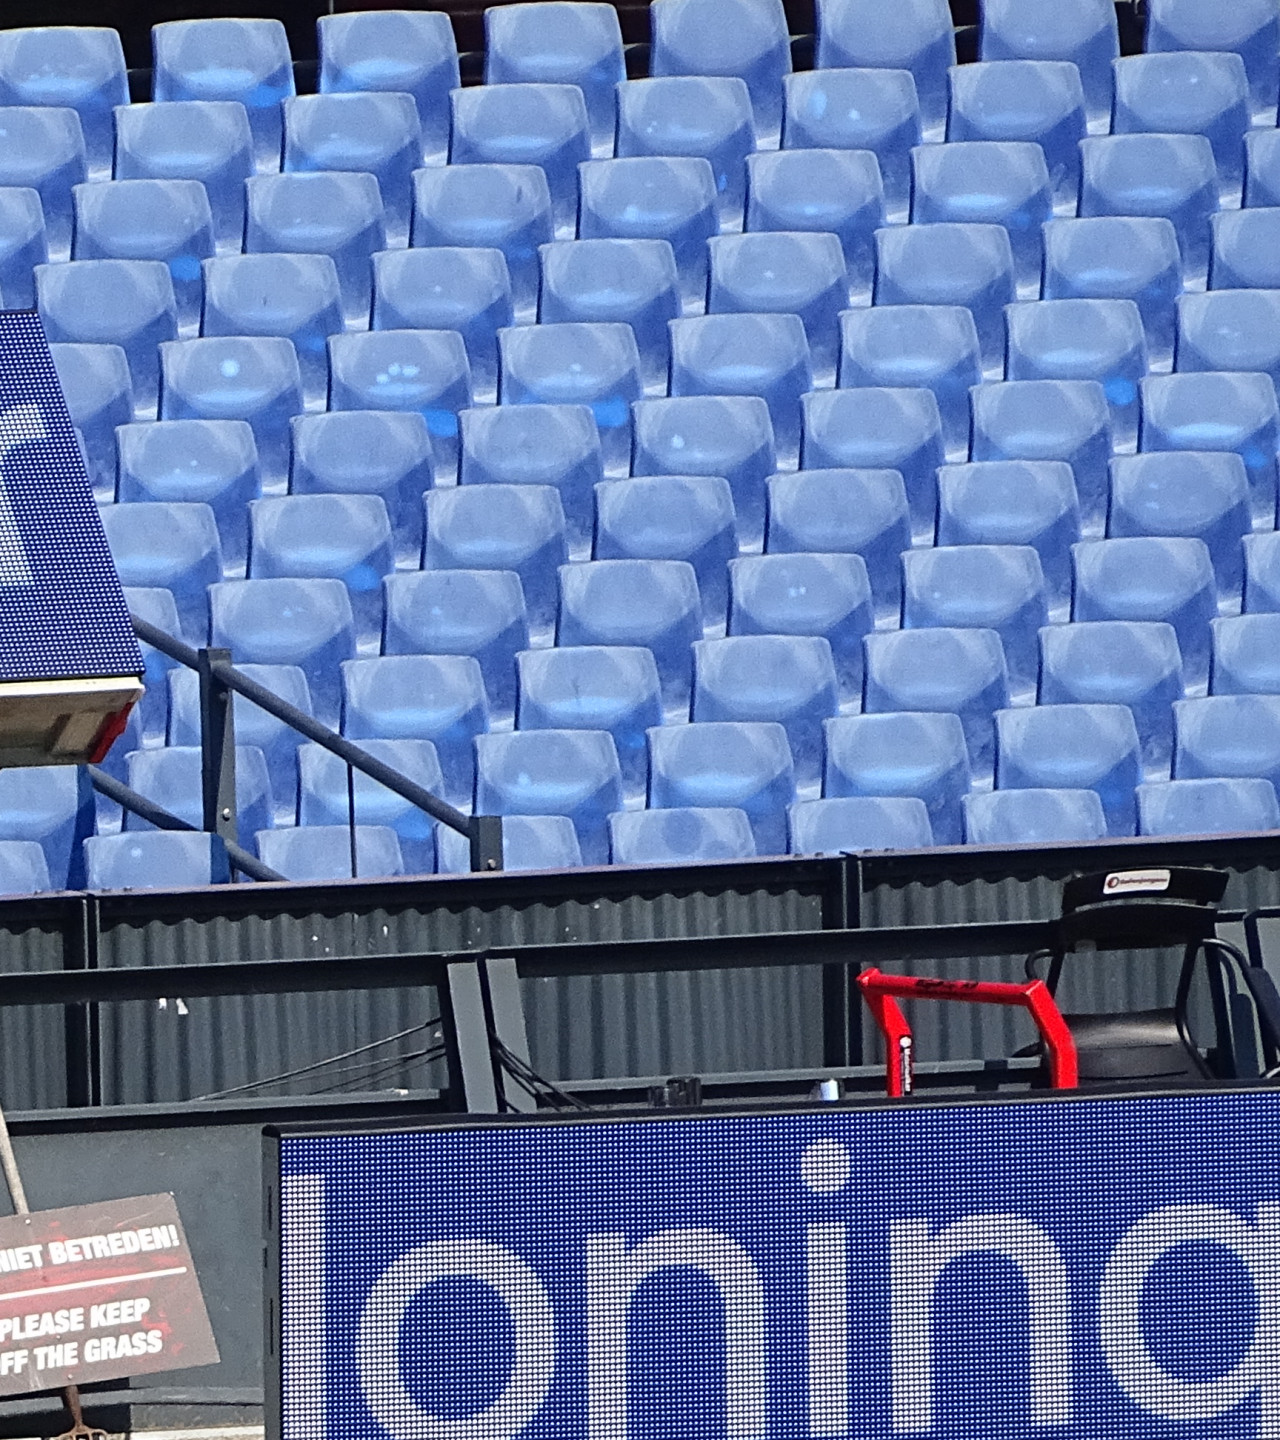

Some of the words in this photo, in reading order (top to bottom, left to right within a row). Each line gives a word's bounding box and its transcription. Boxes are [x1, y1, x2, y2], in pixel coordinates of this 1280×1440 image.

[49, 1224, 181, 1266] BETREDEN!
[88, 1298, 151, 1329] KEEP
[33, 1342, 79, 1370] THE
[83, 1329, 164, 1363] GRASS
